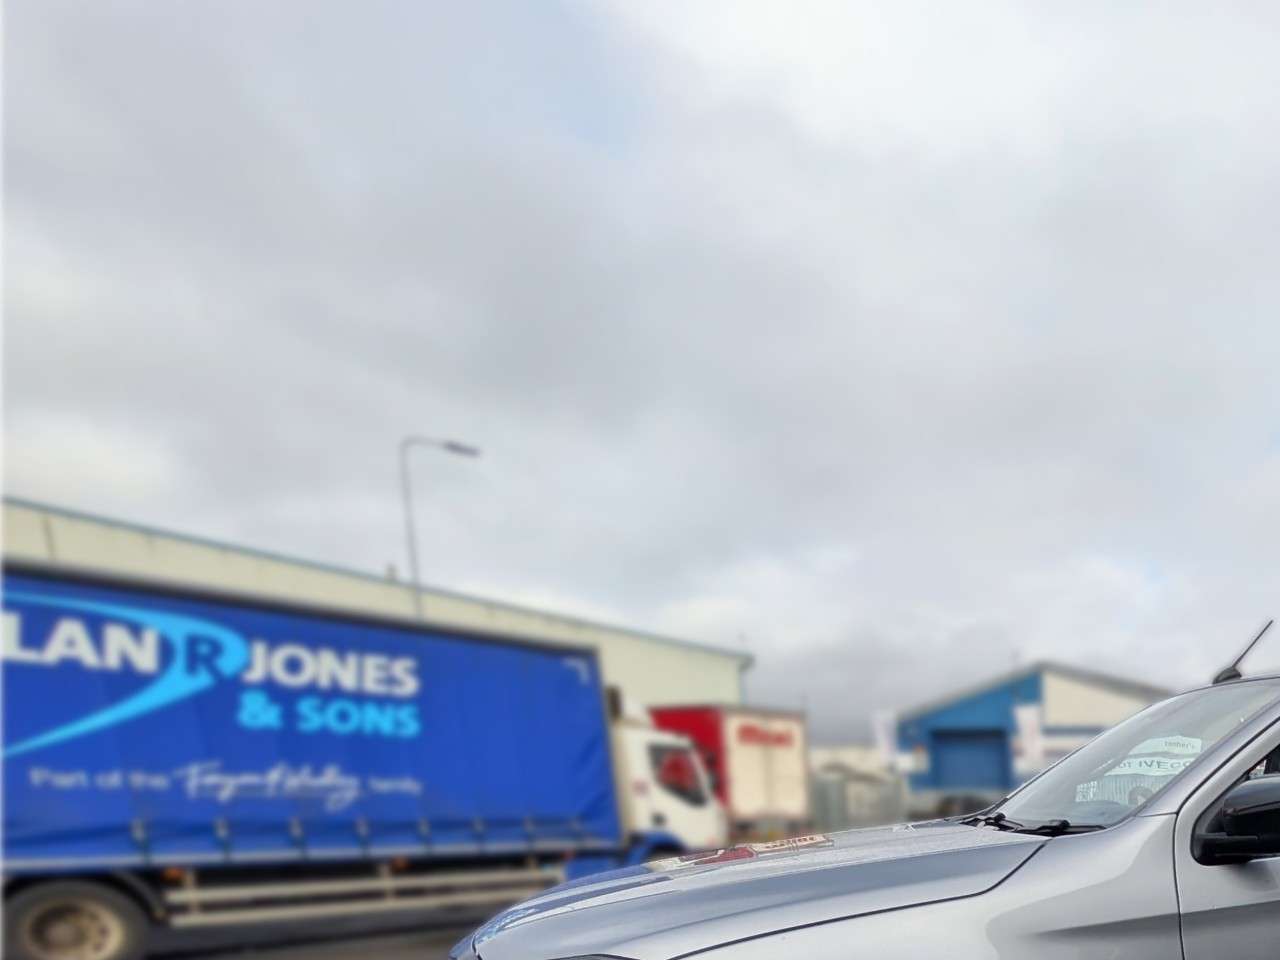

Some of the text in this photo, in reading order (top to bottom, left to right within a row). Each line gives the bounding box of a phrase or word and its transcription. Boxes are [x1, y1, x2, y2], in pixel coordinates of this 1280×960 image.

[184, 633, 224, 686] R
[243, 640, 420, 697] JONES
[238, 689, 421, 738] & SONS
